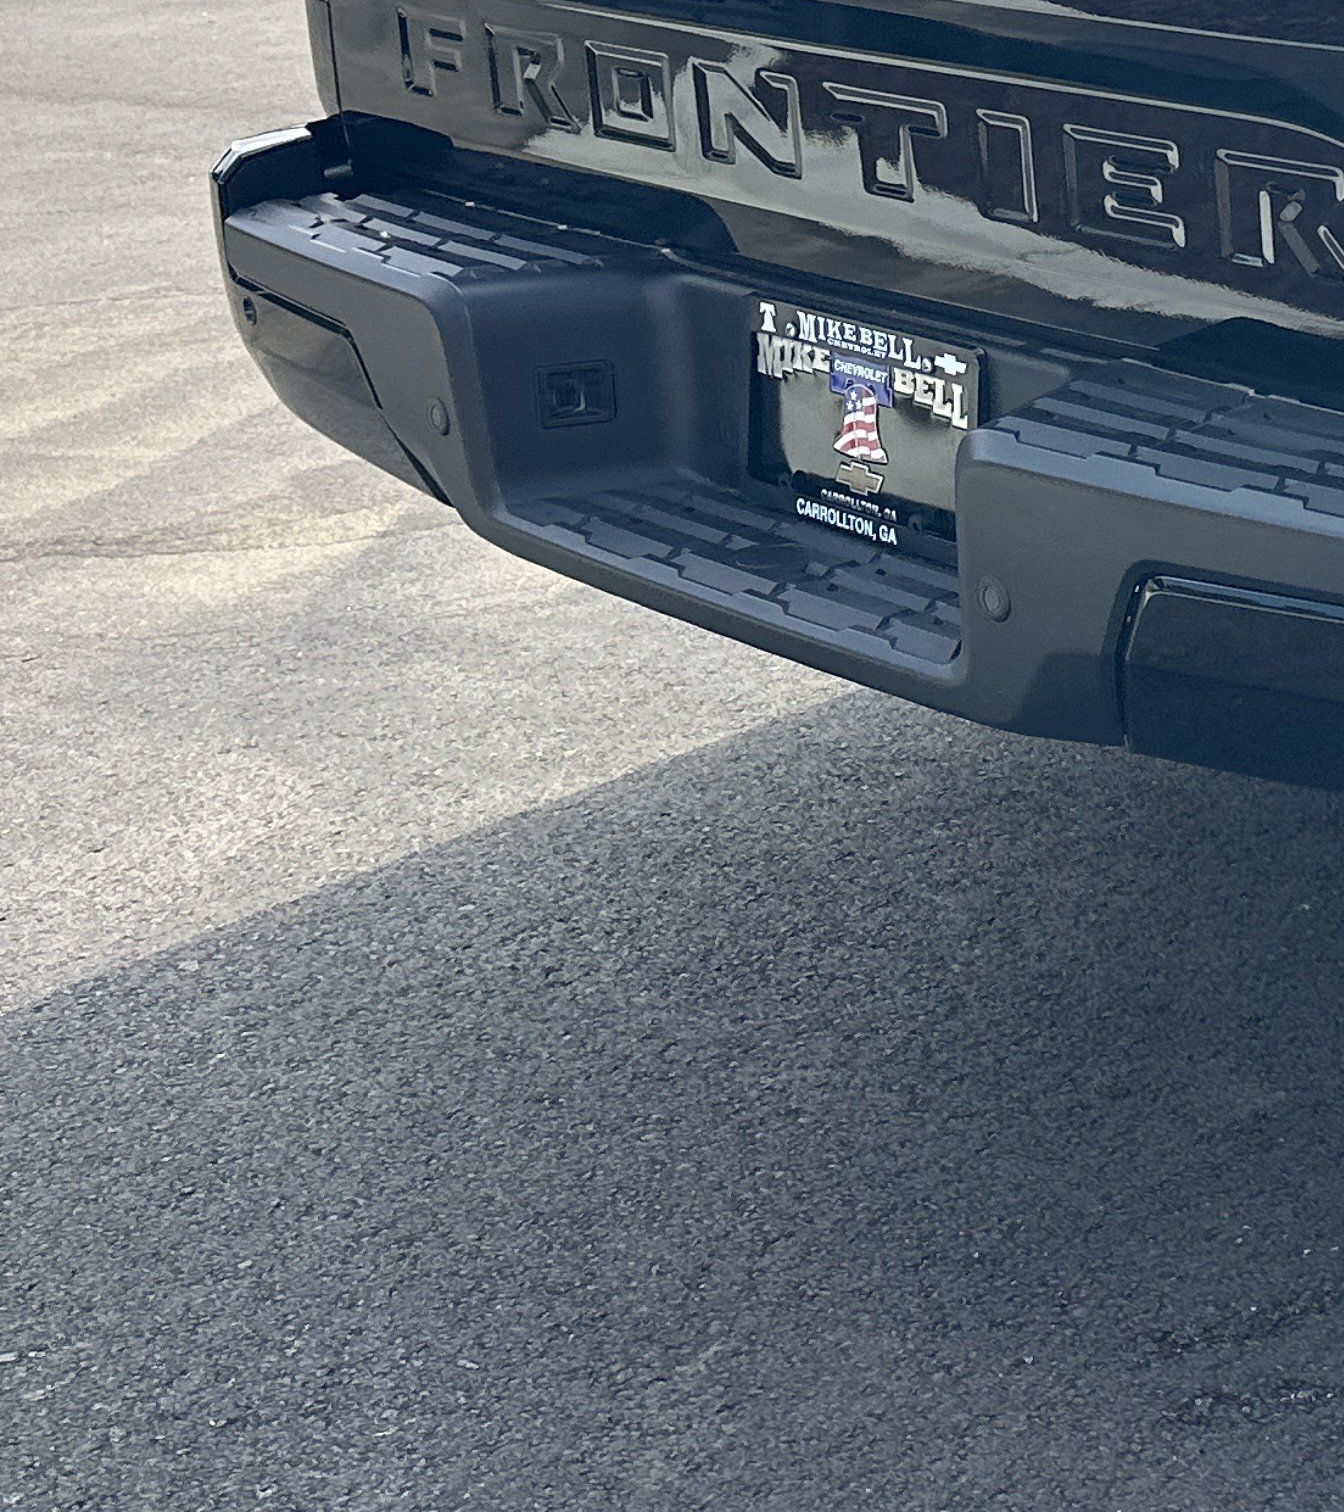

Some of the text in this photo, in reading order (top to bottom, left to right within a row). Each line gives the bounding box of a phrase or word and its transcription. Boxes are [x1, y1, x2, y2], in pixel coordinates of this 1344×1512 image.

[755, 331, 830, 380] MIKE
[796, 310, 858, 345] MIKE
[859, 324, 922, 371] BELL
[827, 338, 888, 359] CHEVROLET
[833, 359, 890, 385] CHEVROLET
[893, 367, 969, 431] BELL
[796, 497, 898, 546] CARROLLTON, GA
